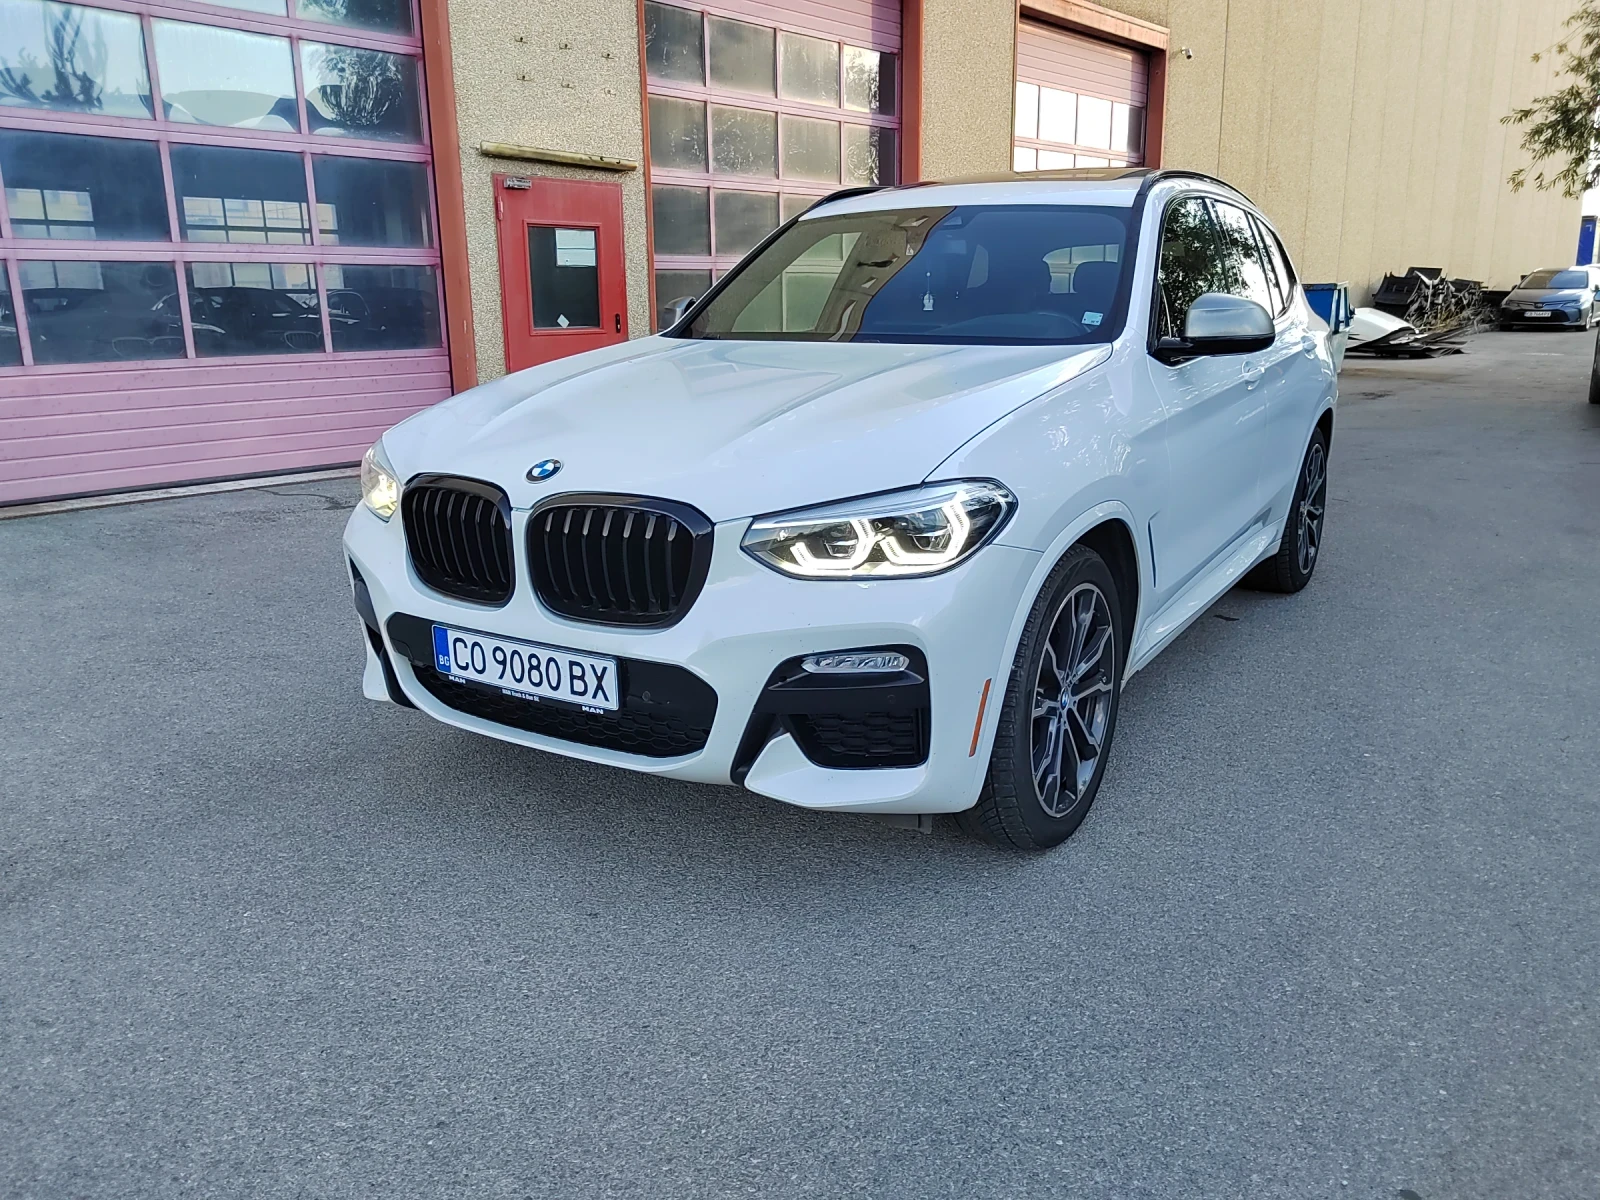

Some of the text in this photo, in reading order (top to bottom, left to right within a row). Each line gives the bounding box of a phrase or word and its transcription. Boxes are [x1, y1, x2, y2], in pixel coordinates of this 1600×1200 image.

[439, 654, 450, 667] BG
[453, 637, 610, 703] CO 9080 BX
[448, 674, 466, 684] MAN
[581, 705, 604, 715] MAN
